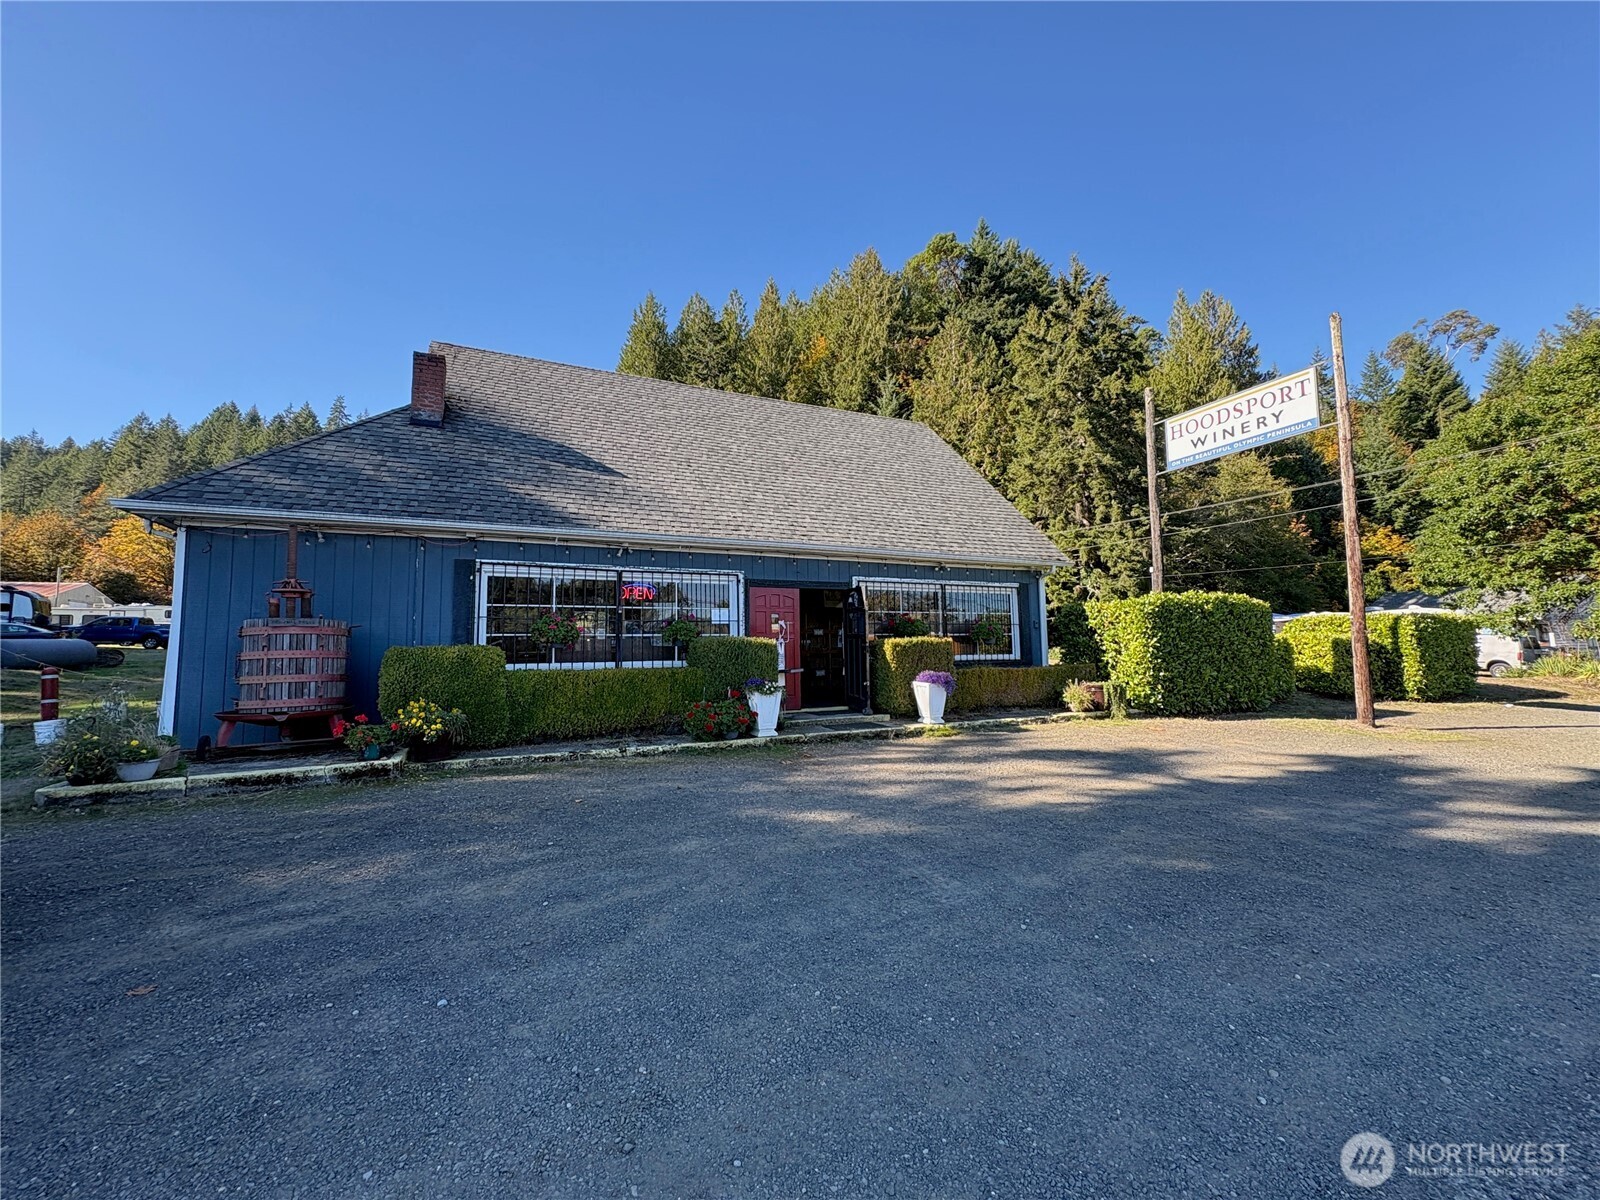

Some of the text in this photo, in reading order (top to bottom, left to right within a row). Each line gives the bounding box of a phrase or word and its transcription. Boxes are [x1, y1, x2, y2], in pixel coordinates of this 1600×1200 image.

[1170, 378, 1312, 441] HOODSPORT
[1190, 410, 1284, 449] WINERY
[1182, 456, 1194, 464] THE
[1195, 445, 1232, 460] BEAUTIFUL
[1233, 435, 1265, 448] OLYMPIC
[1266, 420, 1312, 439] PENINSULA
